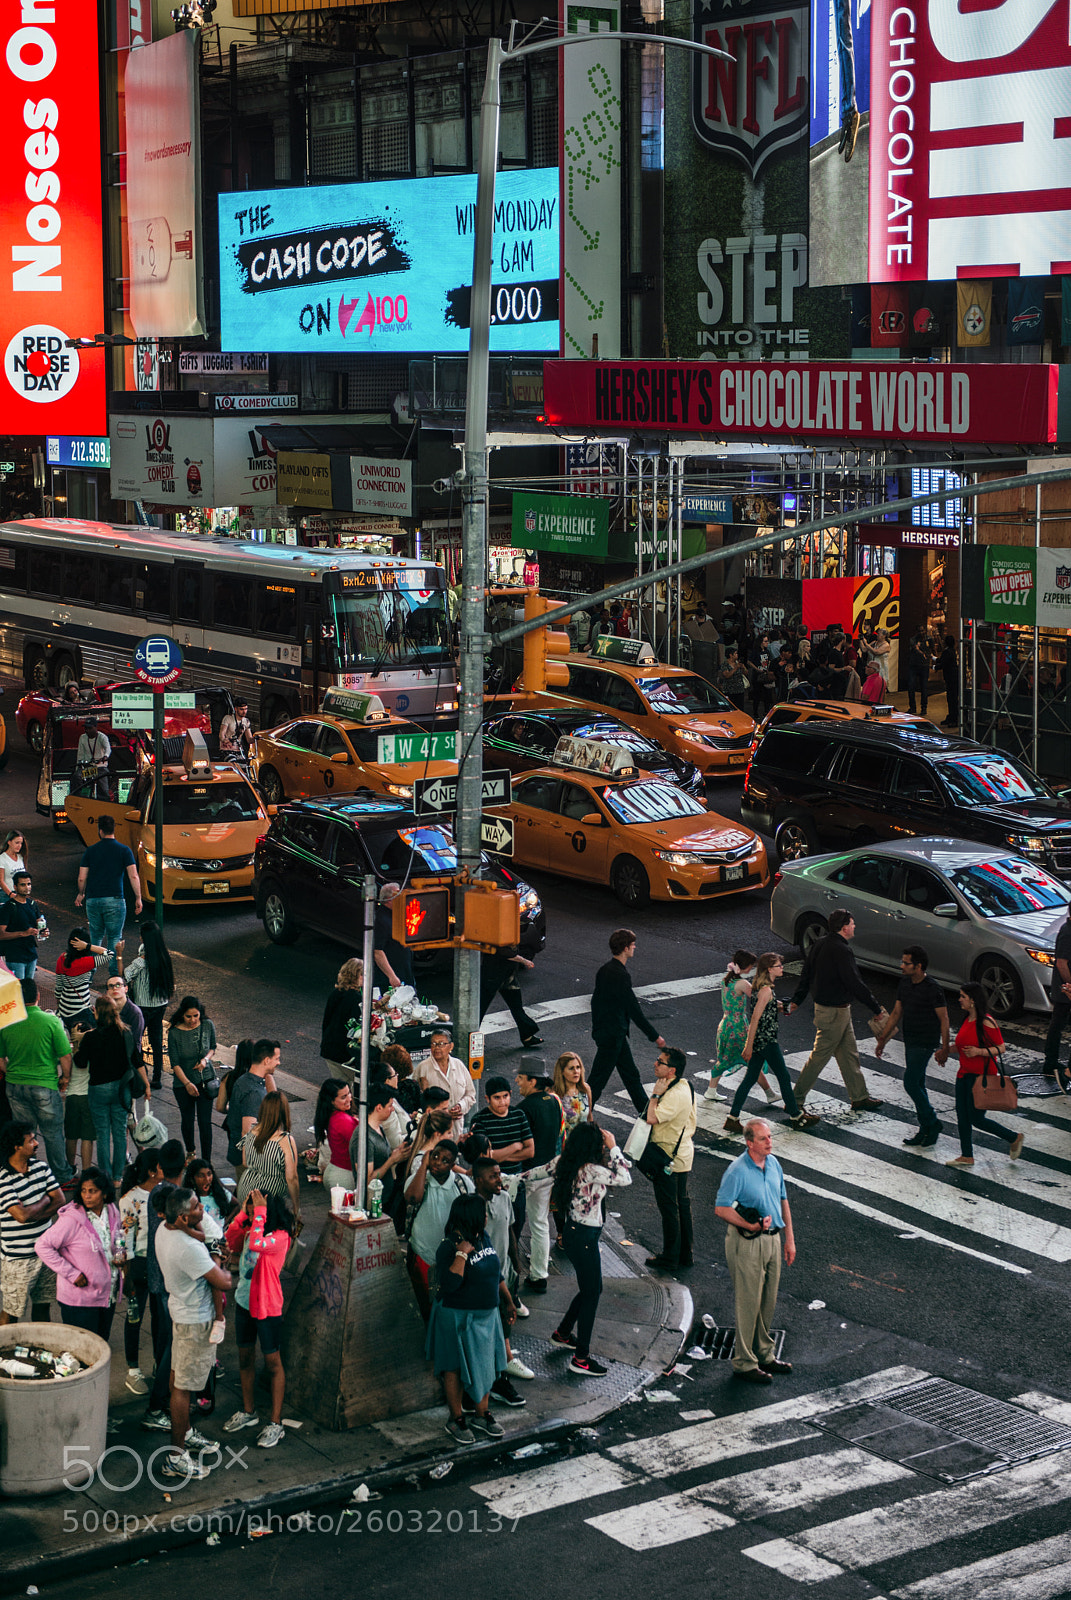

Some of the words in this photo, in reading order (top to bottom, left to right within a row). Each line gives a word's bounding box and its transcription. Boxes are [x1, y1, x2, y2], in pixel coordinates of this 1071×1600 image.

[704, 16, 809, 137] NFL
[886, 6, 917, 266] CHOCOLATE
[12, 98, 62, 292] Noses
[234, 204, 275, 236] THE
[493, 198, 556, 233] MONDAY
[250, 235, 312, 284] CASH
[315, 230, 388, 281] CODE
[500, 238, 535, 274] 6AM
[696, 232, 808, 325] STEP
[298, 297, 331, 336] ON
[23, 336, 63, 353] RED
[697, 329, 753, 346] INTO
[760, 329, 810, 345] THE
[180, 355, 198, 370] GIFTS
[203, 355, 234, 370] LUGGAGE
[240, 354, 268, 371] T-SHIRT
[23, 373, 63, 391] DAY
[595, 367, 713, 426] HERSHEY'S
[719, 368, 863, 431] CHOCOLATE
[869, 370, 970, 434] WORLD
[147, 465, 174, 481] COMEDY
[247, 457, 273, 471] TIMES
[279, 464, 310, 477] PLAYLAND
[312, 466, 329, 479] GIFTS
[360, 464, 401, 479] UNIWORLD
[161, 480, 176, 493] CLUB
[357, 478, 406, 493] CONNECTION
[687, 498, 727, 512] EXPERIENCE
[538, 513, 596, 536] EXPERIENCE
[901, 531, 960, 547] HERSHEY'S
[991, 560, 1014, 568] COMING
[1014, 561, 1031, 569] SOON
[343, 571, 366, 587] BxM2
[989, 576, 1008, 593] NOW
[1009, 572, 1033, 590] OPEN!
[991, 589, 1030, 606] 2017
[762, 606, 785, 627] STEP
[137, 669, 147, 680] NO
[147, 669, 179, 685] STANDING
[342, 676, 360, 685] 3085
[336, 696, 363, 710] EXPERIENCE
[398, 737, 413, 760] W
[420, 737, 437, 759] 47
[444, 735, 455, 750] St
[429, 786, 456, 802] ONE
[481, 781, 499, 796] AY
[484, 825, 505, 843] WAY
[356, 1250, 397, 1273] ELECTRIC
